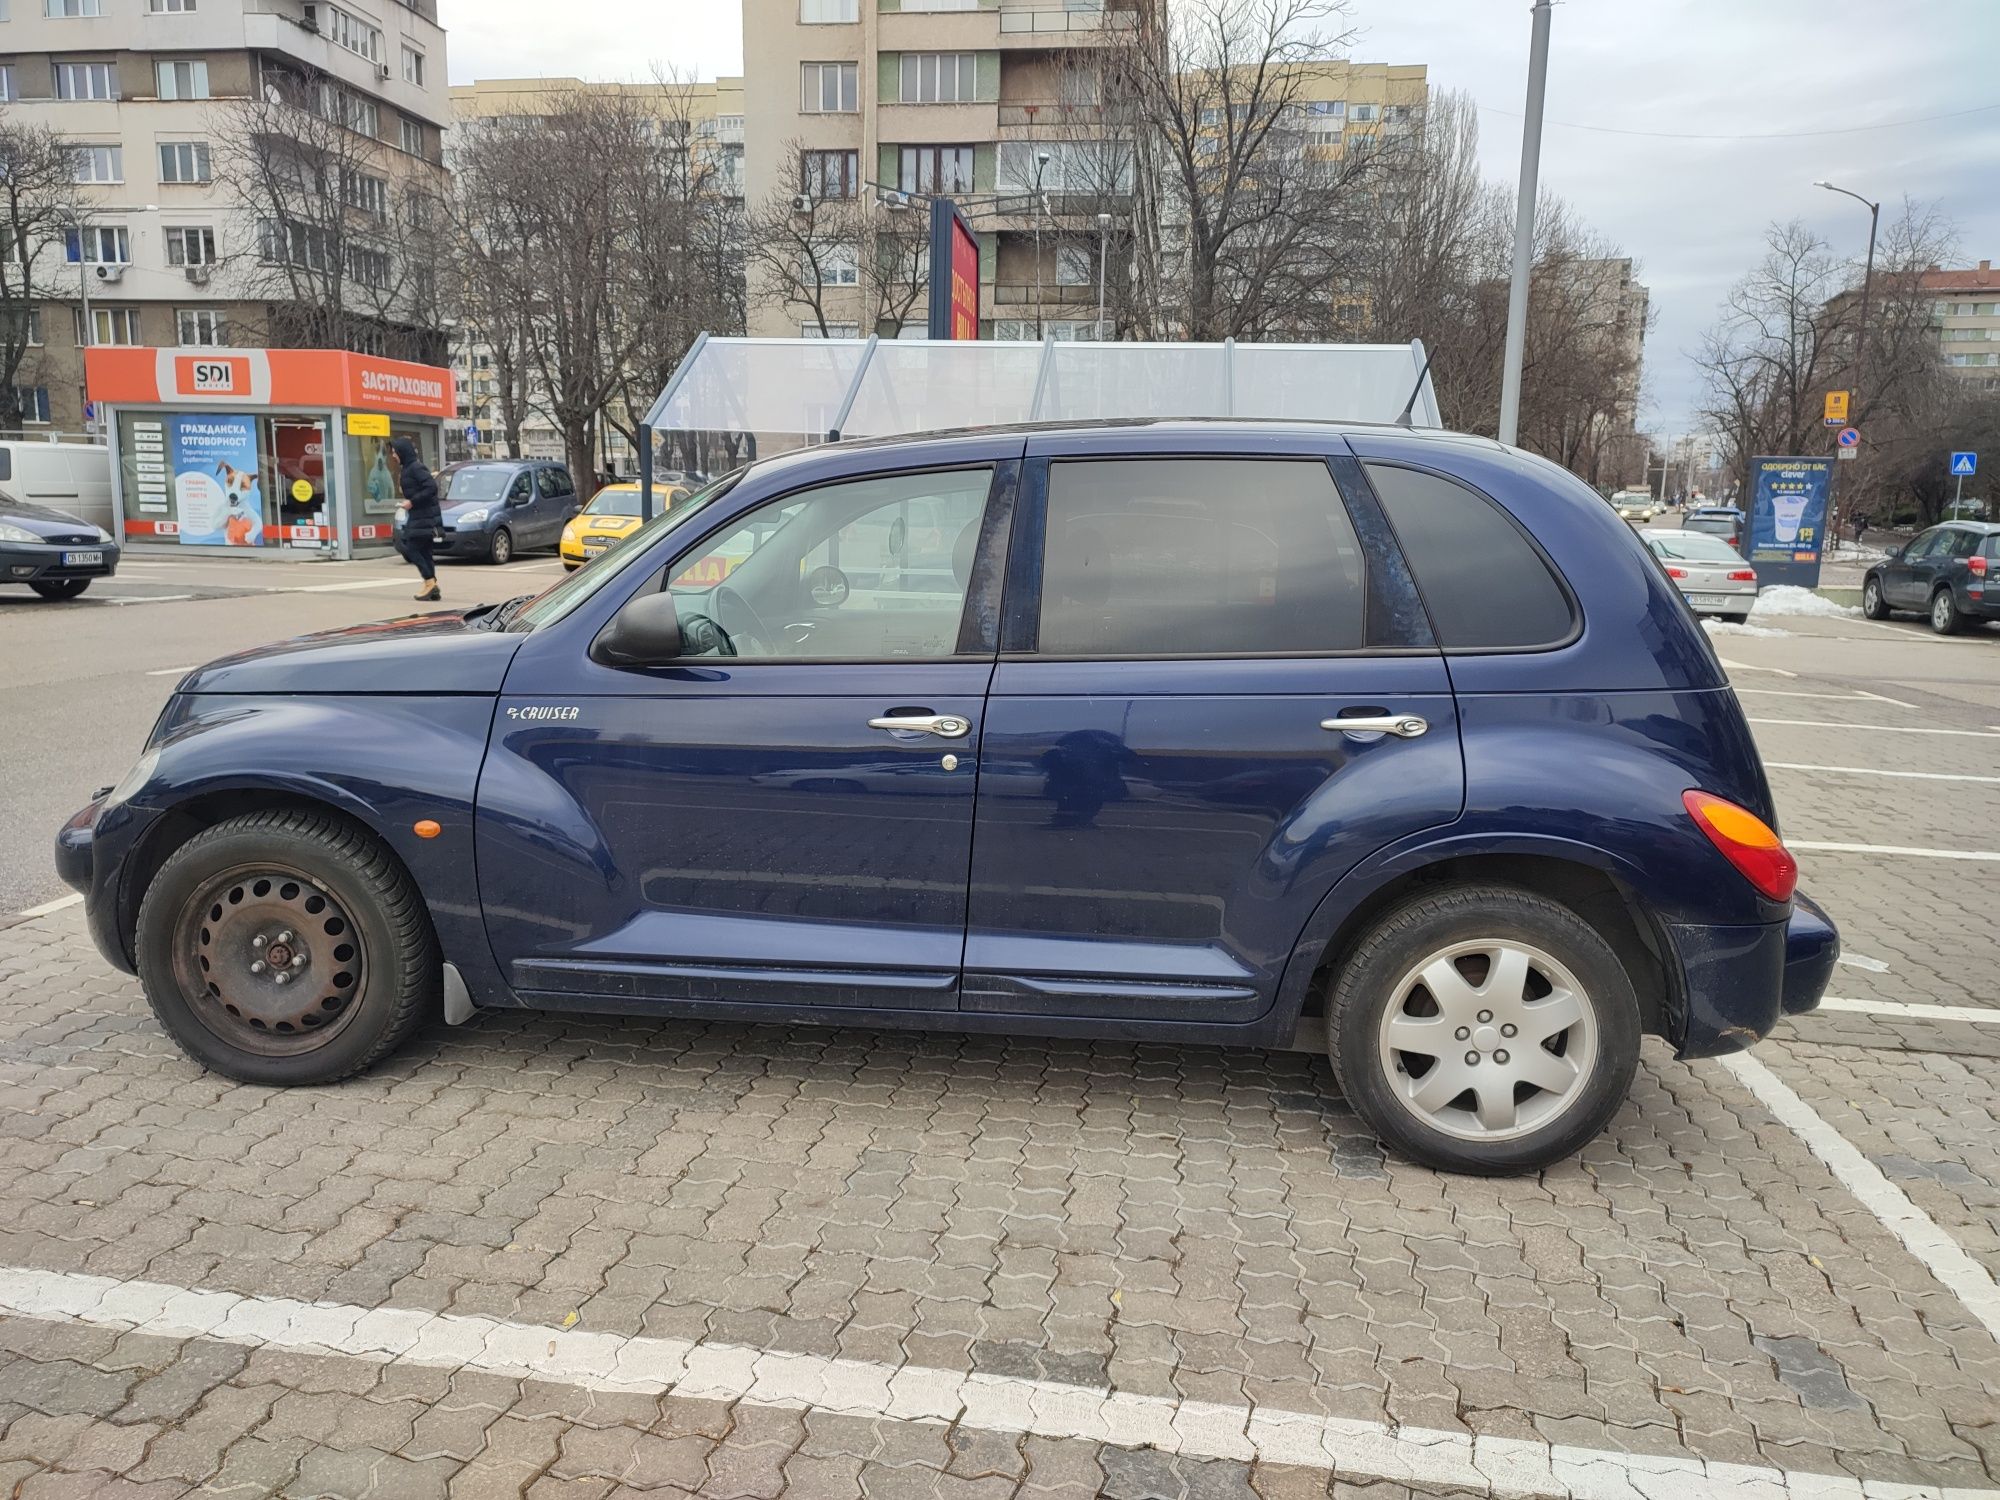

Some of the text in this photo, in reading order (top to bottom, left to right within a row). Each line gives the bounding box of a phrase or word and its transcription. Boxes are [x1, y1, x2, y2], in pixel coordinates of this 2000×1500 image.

[196, 365, 230, 382] SDI
[361, 370, 442, 398] ЗАСТРАХОВКИ
[180, 424, 247, 435] ГРАЖДАНСКА
[181, 436, 247, 446] ОТГОВОРНОСТ
[1781, 470, 1805, 478] clever
[520, 706, 580, 720] CRUISER
